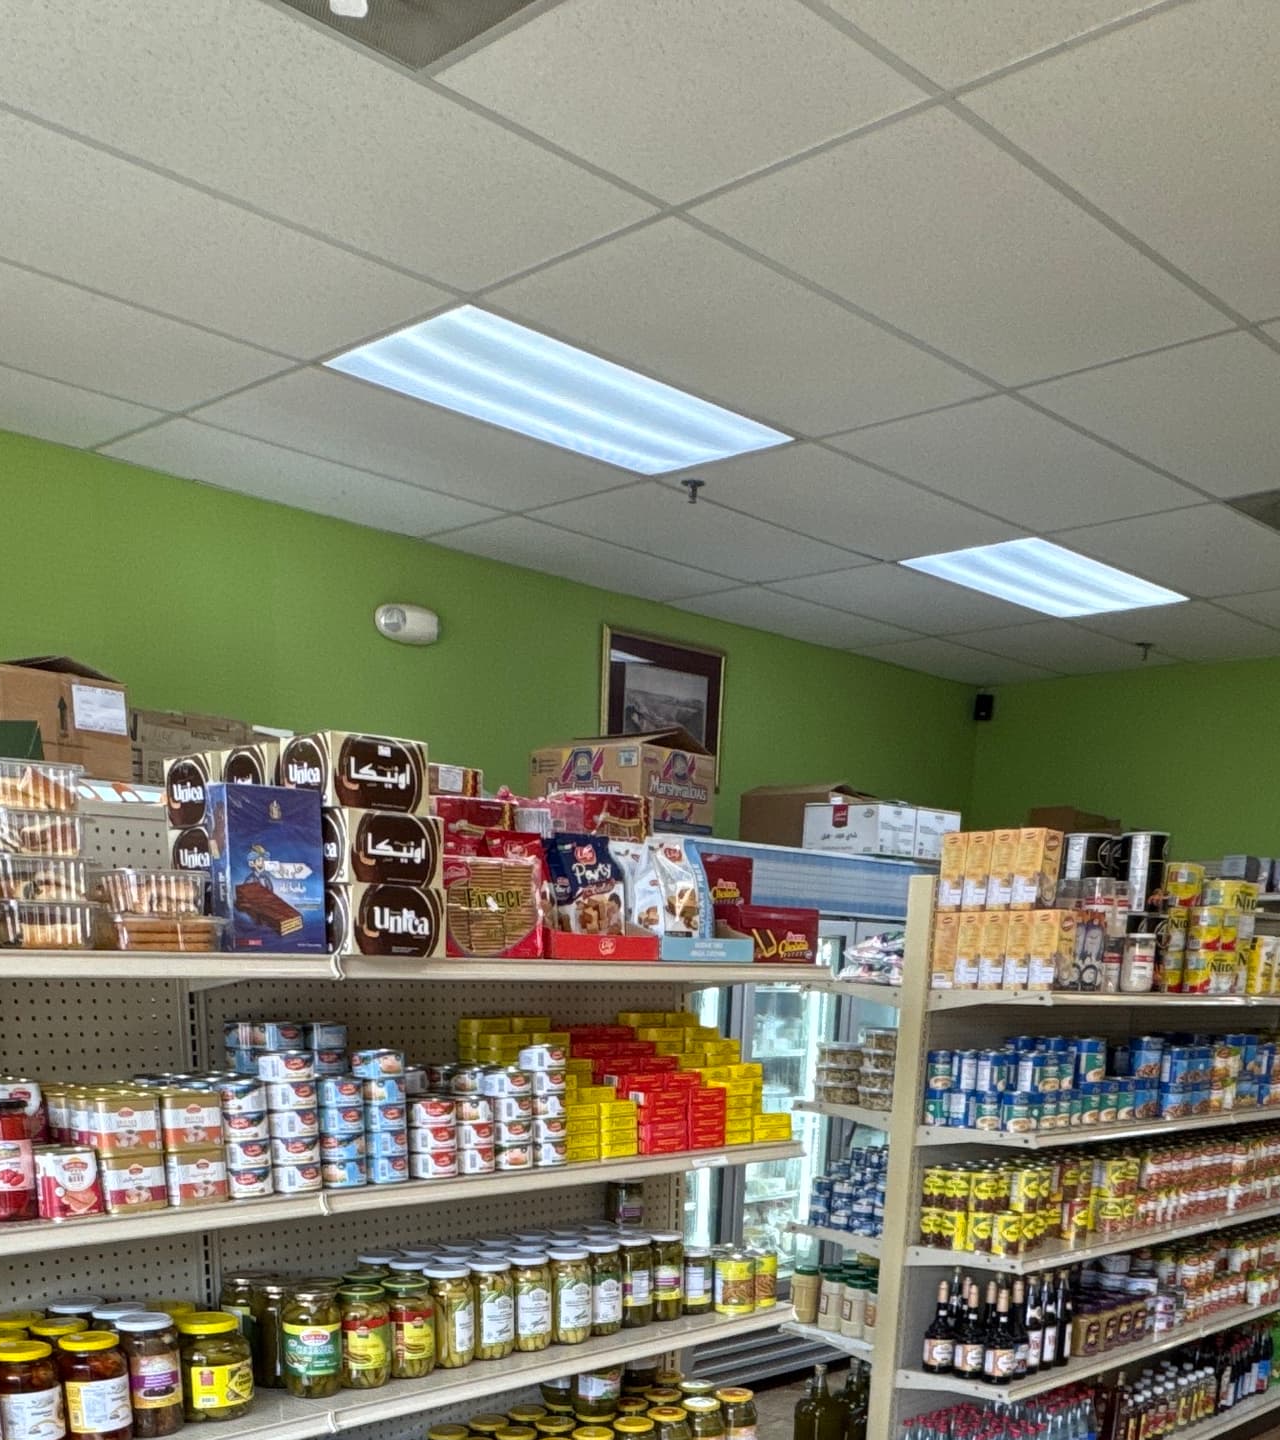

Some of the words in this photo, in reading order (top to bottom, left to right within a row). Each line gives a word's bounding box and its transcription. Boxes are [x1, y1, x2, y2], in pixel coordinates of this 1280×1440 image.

[288, 762, 321, 784] Unica
[172, 781, 204, 804] Unica
[179, 847, 210, 869] Unica
[373, 905, 430, 936] Unica
